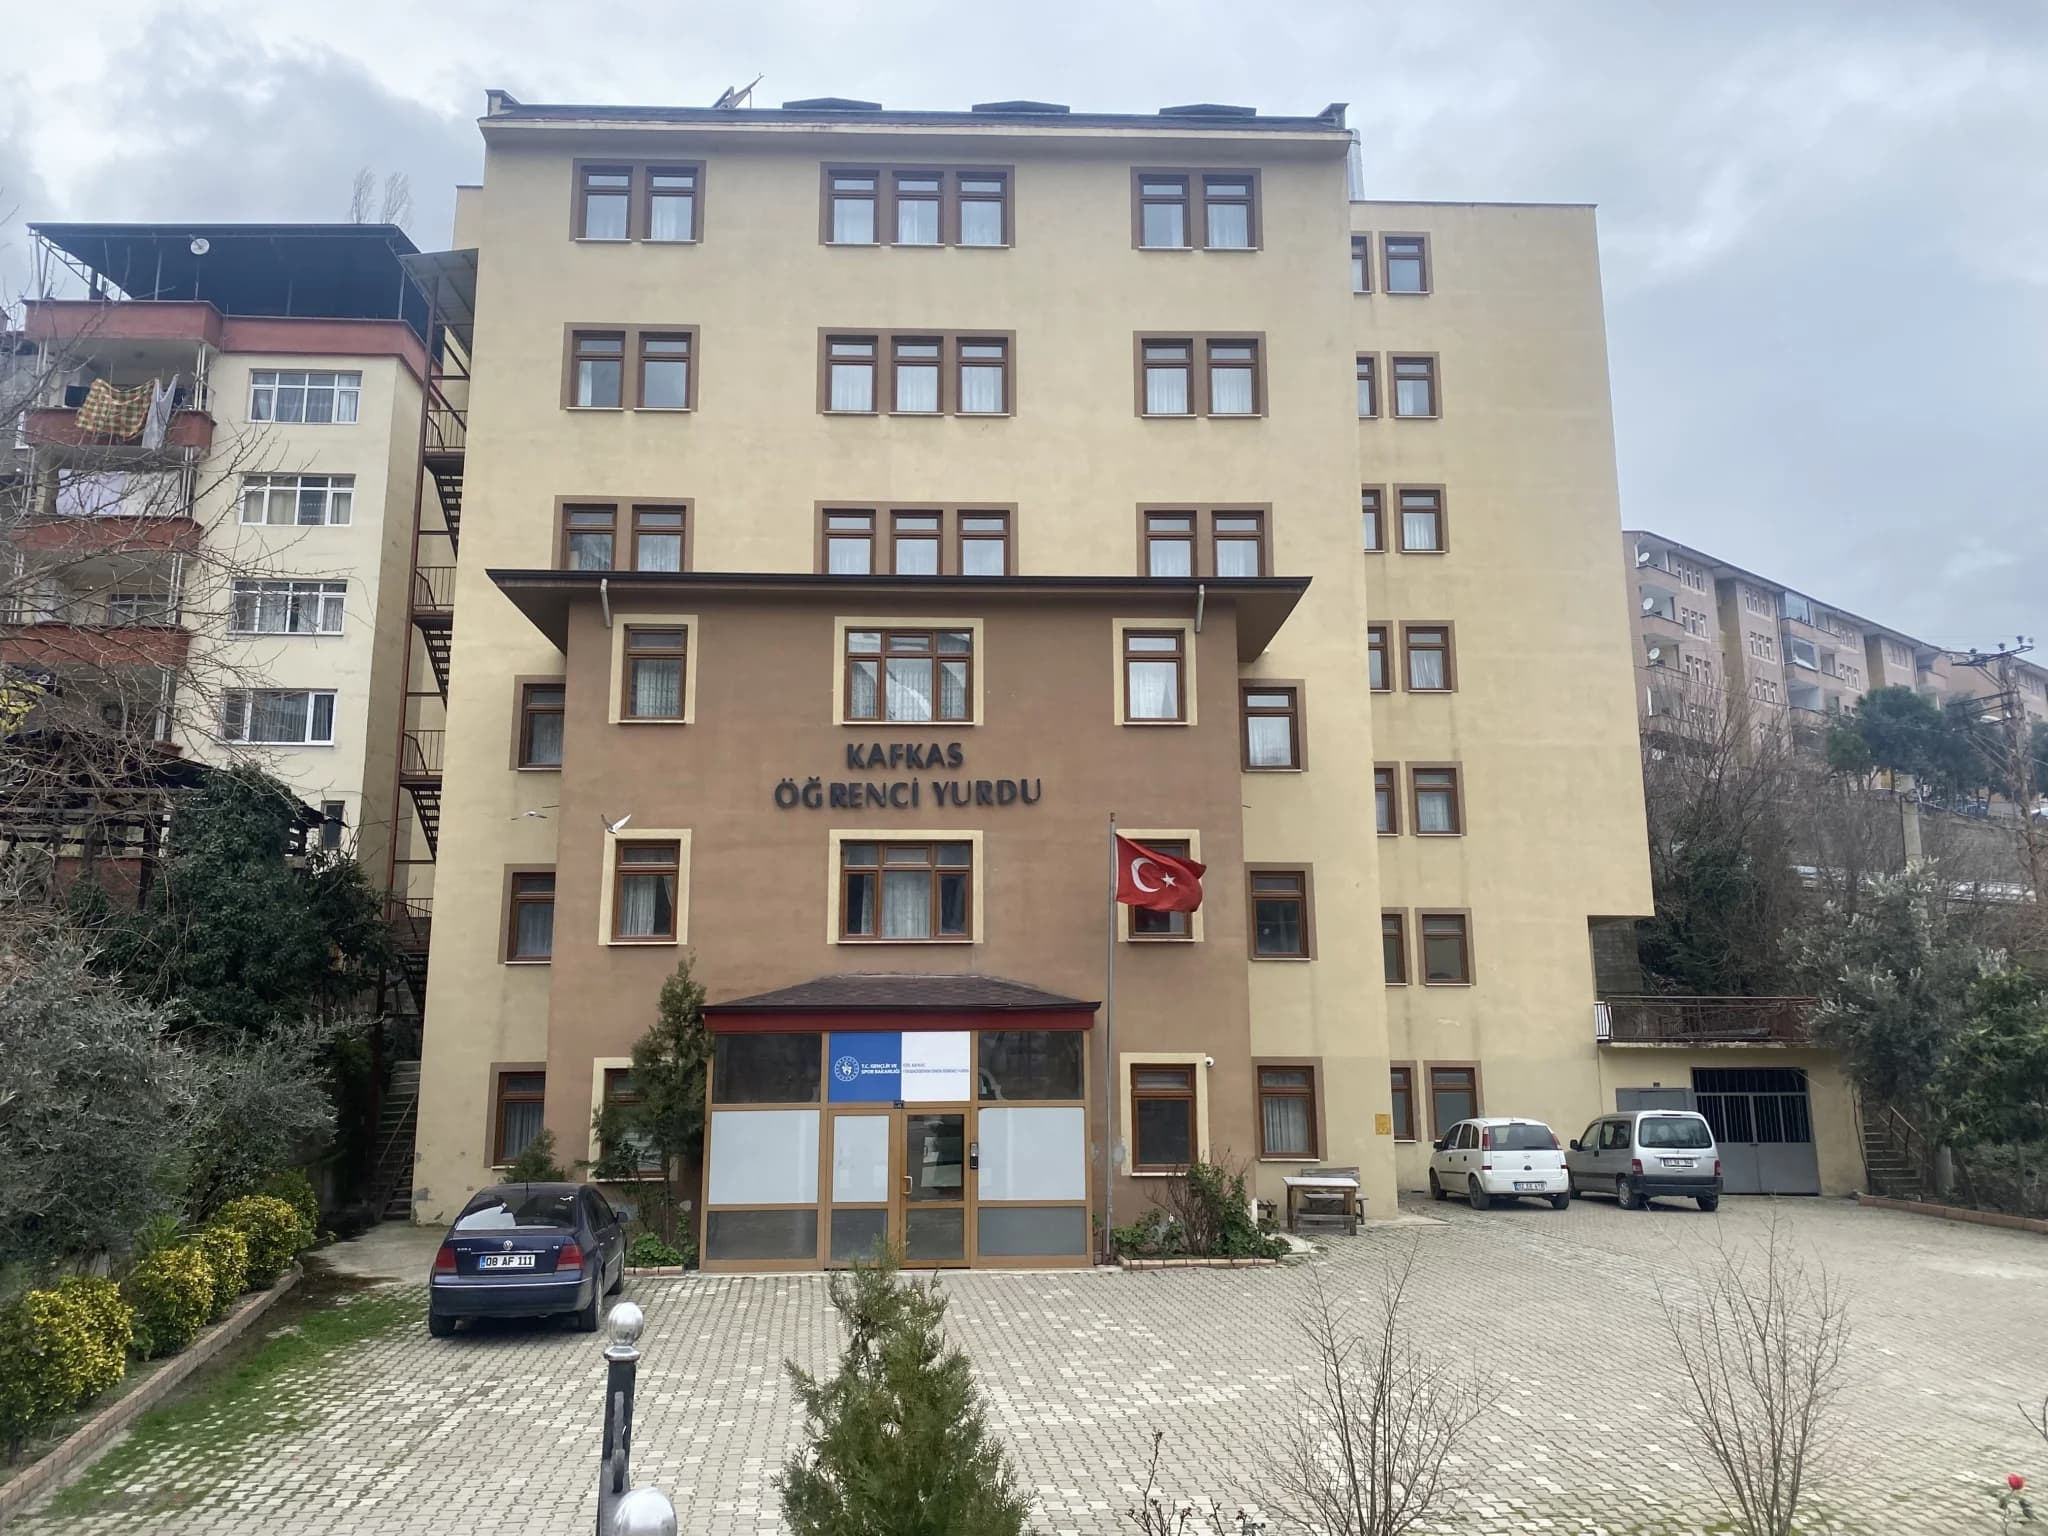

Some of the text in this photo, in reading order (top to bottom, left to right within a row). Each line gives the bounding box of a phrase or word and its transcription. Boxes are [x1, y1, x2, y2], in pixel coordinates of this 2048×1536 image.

[846, 742, 964, 770] KAFKAS
[774, 776, 1041, 809] ÖĞRENCİ YURDU
[486, 1256, 533, 1266] 08 AF 111
